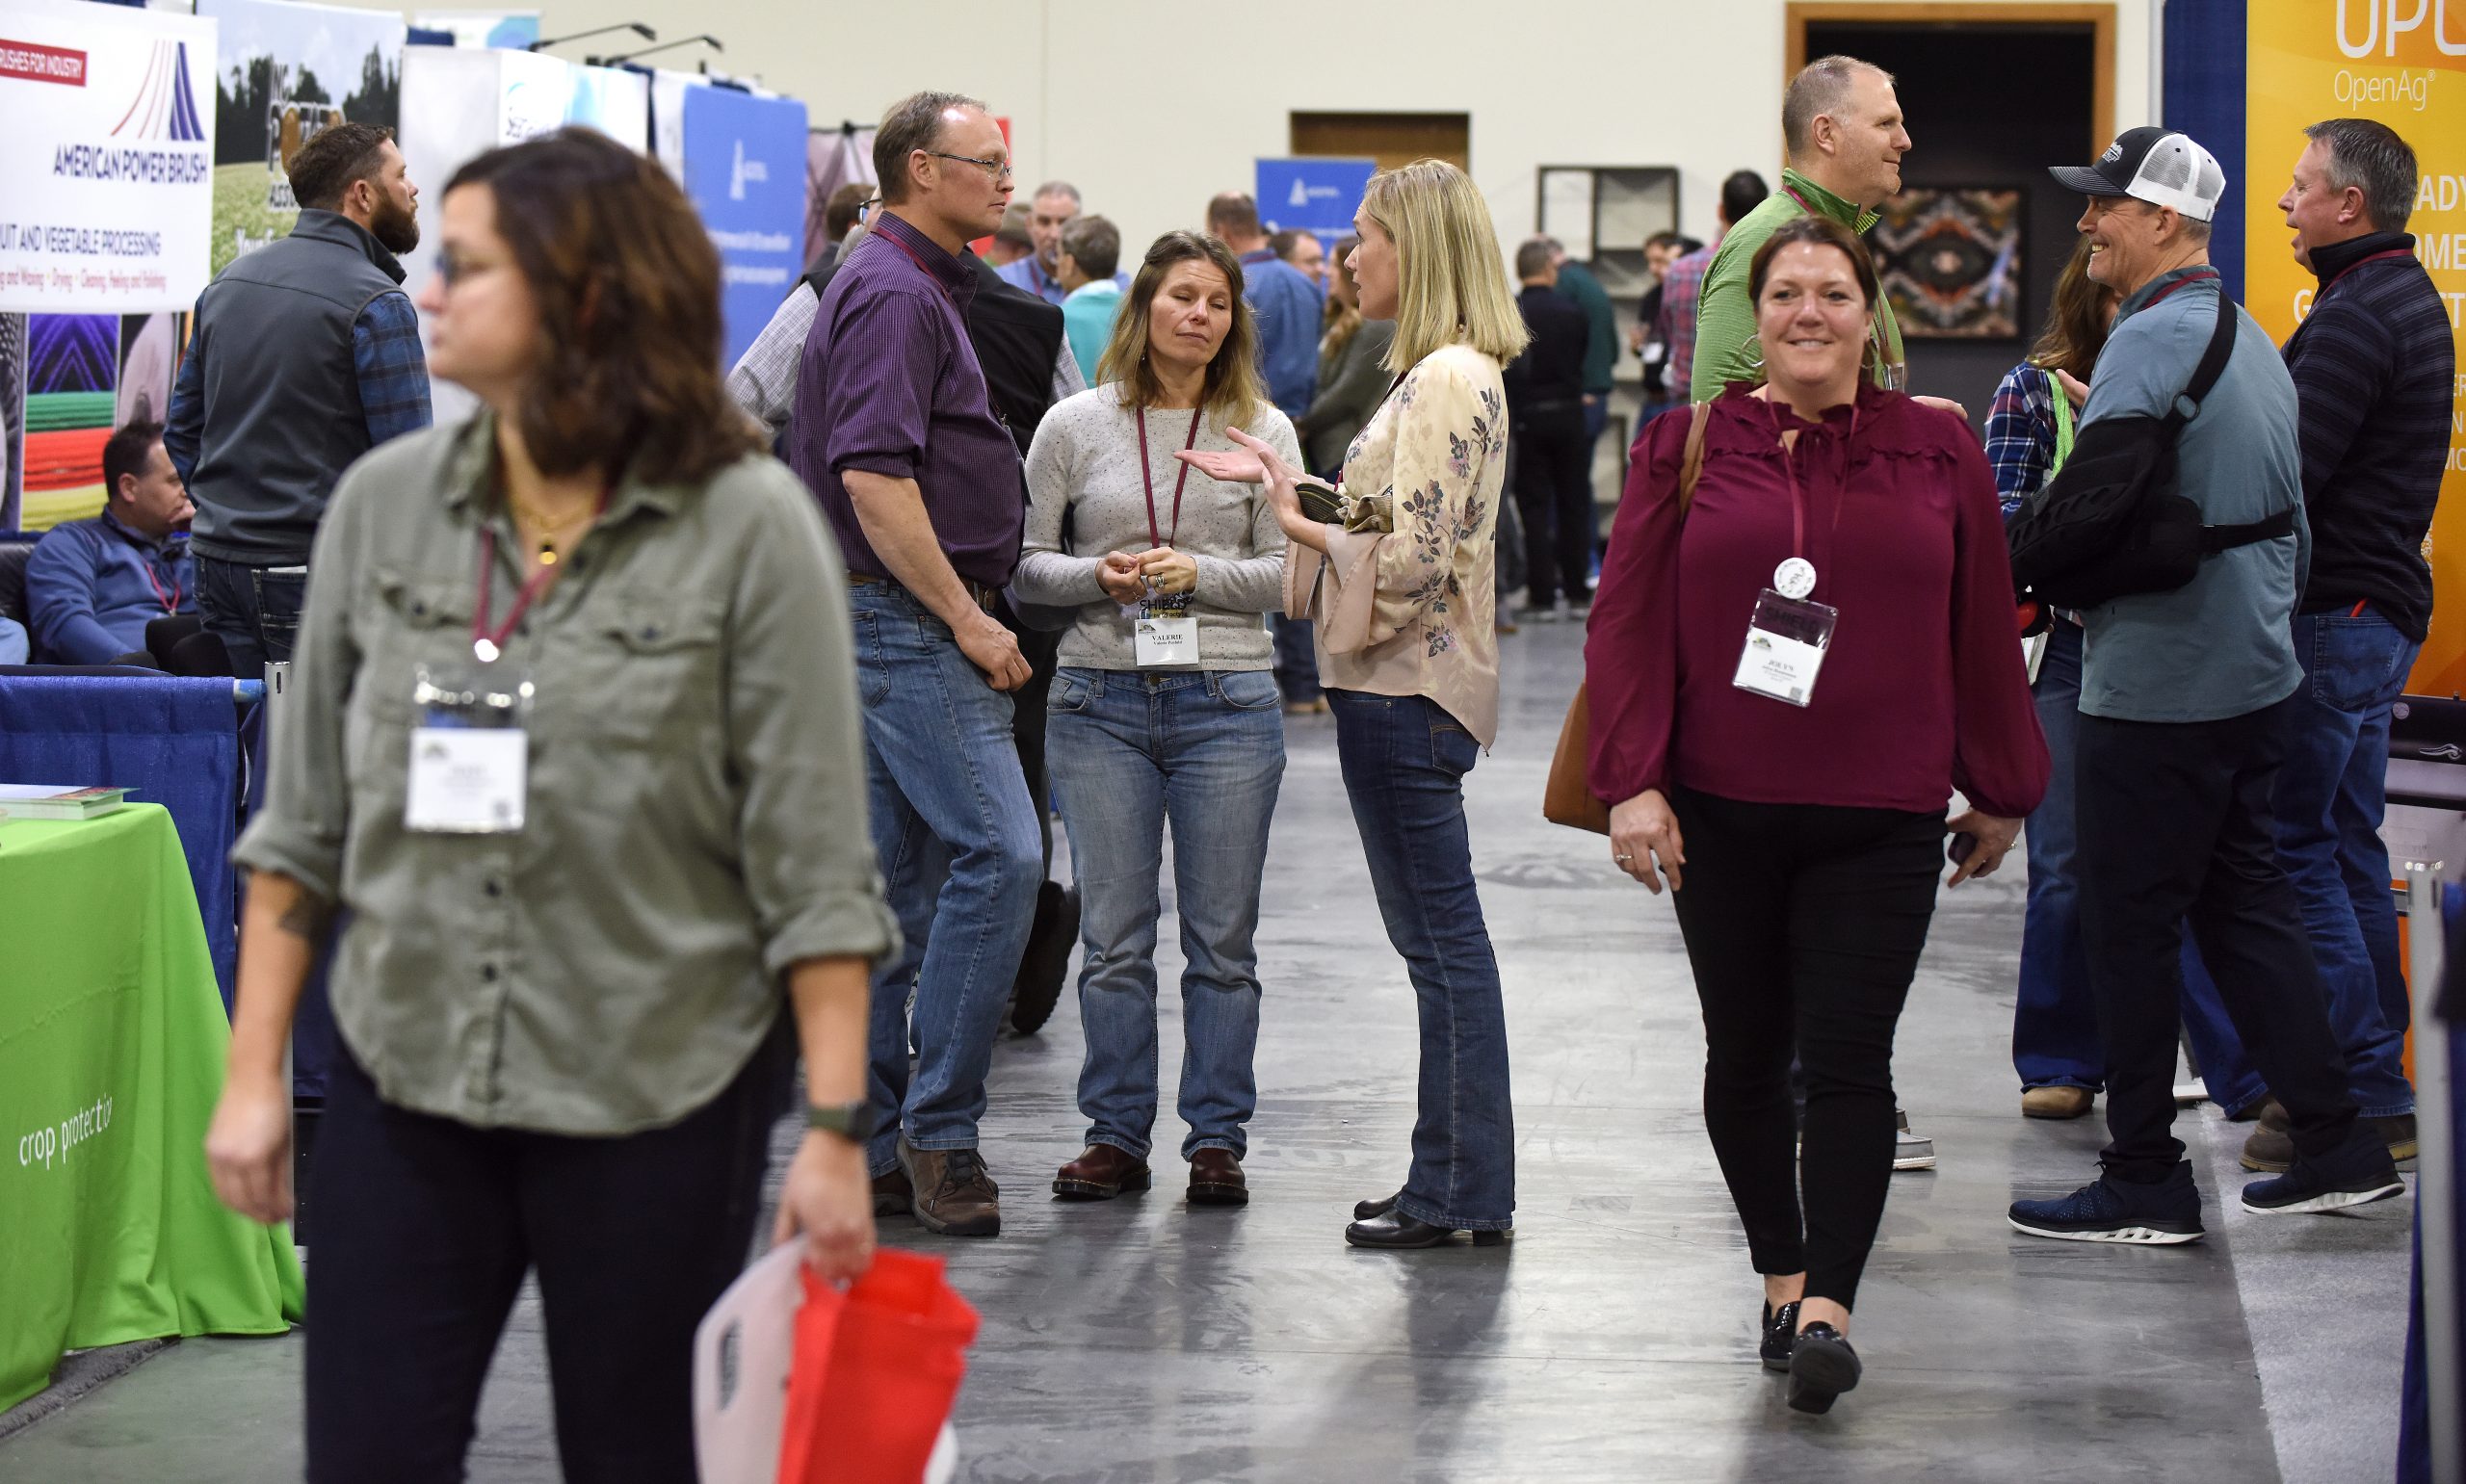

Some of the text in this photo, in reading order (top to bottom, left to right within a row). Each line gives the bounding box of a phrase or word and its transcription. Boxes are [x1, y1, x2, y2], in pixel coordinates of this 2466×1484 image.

[2335, 0, 2466, 58] UPL
[30, 52, 45, 74] FOR
[46, 54, 84, 78] INDUSTRY
[54, 144, 209, 183] AMERICAN POWER BRUSH
[19, 226, 41, 251] AND
[45, 227, 98, 254] VEGETABLE
[101, 230, 161, 257] PROCESSING
[19, 1126, 55, 1171] crop
